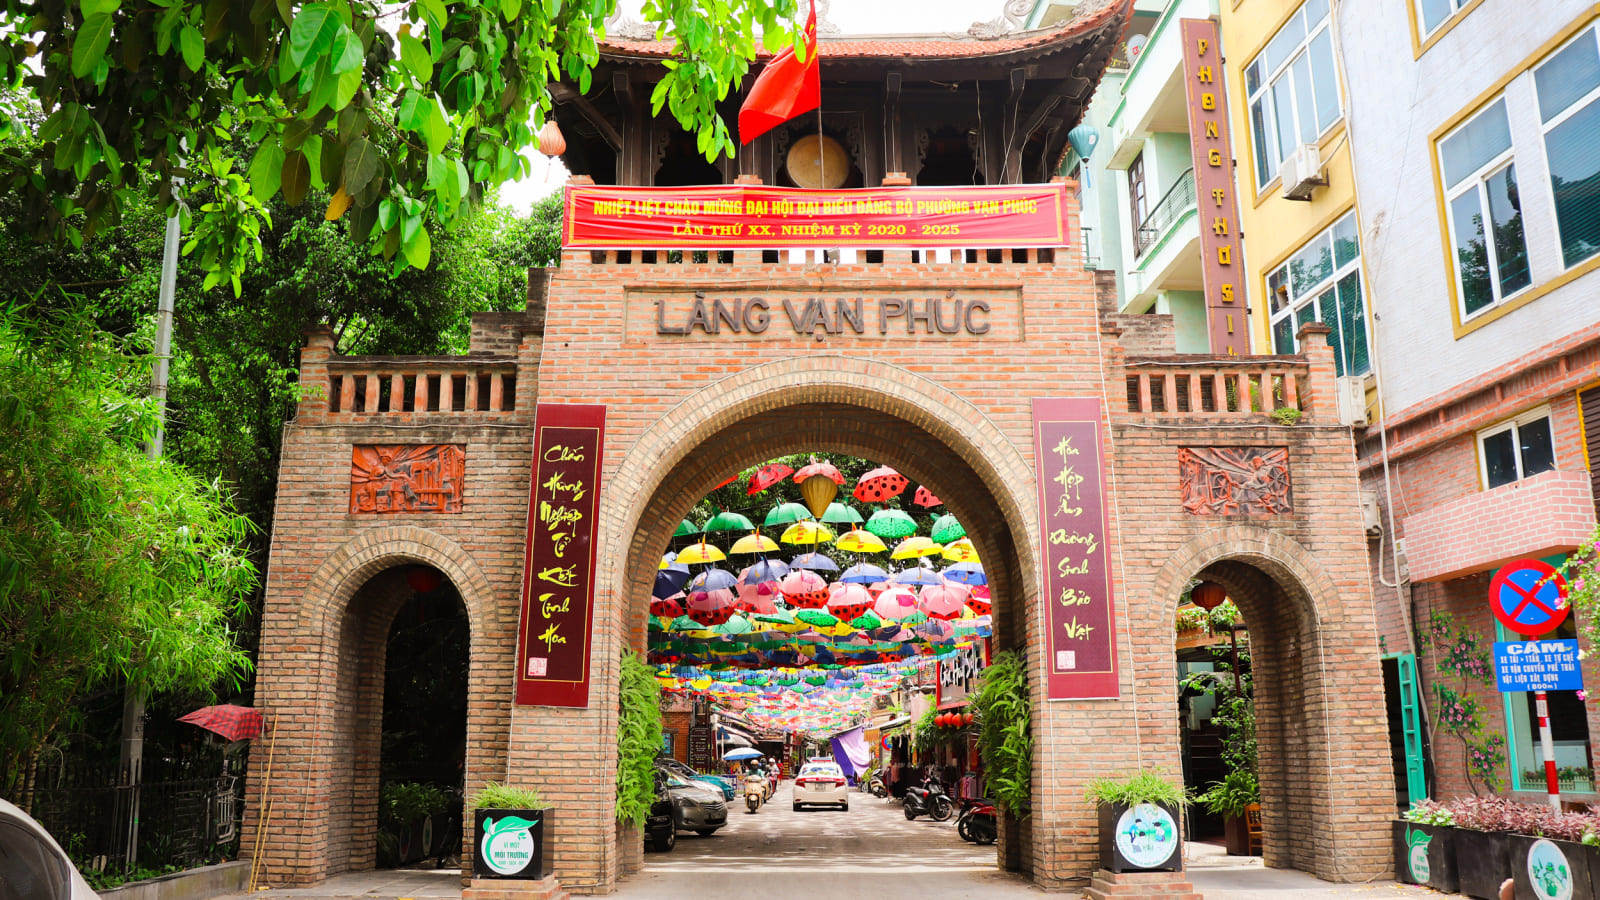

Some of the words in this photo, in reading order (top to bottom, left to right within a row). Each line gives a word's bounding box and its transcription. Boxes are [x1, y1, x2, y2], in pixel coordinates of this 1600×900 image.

[594, 198, 632, 218] NHIỆT
[635, 198, 662, 218] LIỆT
[665, 197, 700, 215] CHÀO
[703, 197, 743, 215] MỪNG
[746, 200, 769, 218] ĐẠI
[772, 198, 794, 218] HỘI
[797, 200, 820, 218] ĐẠI
[823, 196, 853, 215] BIỂU
[856, 196, 892, 215] ĐẢNG
[896, 198, 914, 218] BỘ
[917, 197, 970, 215] PHƯỜNG
[972, 200, 1000, 217] VẠN
[1003, 196, 1038, 214] PHÚC
[673, 219, 705, 236] LẦN
[710, 222, 744, 236] THỨ
[748, 225, 776, 237] XX,
[782, 222, 835, 238] NHIỆM
[840, 222, 863, 236] KỲ
[868, 225, 907, 236] 2020
[922, 225, 960, 236] 2025
[656, 291, 771, 334] LÀNG
[782, 298, 865, 342] VẠN
[880, 290, 991, 335] PHÚC
[544, 444, 585, 462] Chấn
[540, 500, 583, 537] Nghiệp
[537, 563, 579, 587] Kết
[1058, 556, 1089, 578] Sinh
[538, 593, 570, 619] Tinh
[1060, 586, 1091, 606] Bảo
[538, 622, 567, 653] Hoa
[1064, 615, 1095, 641] Vật
[1507, 640, 1565, 654] CẤM
